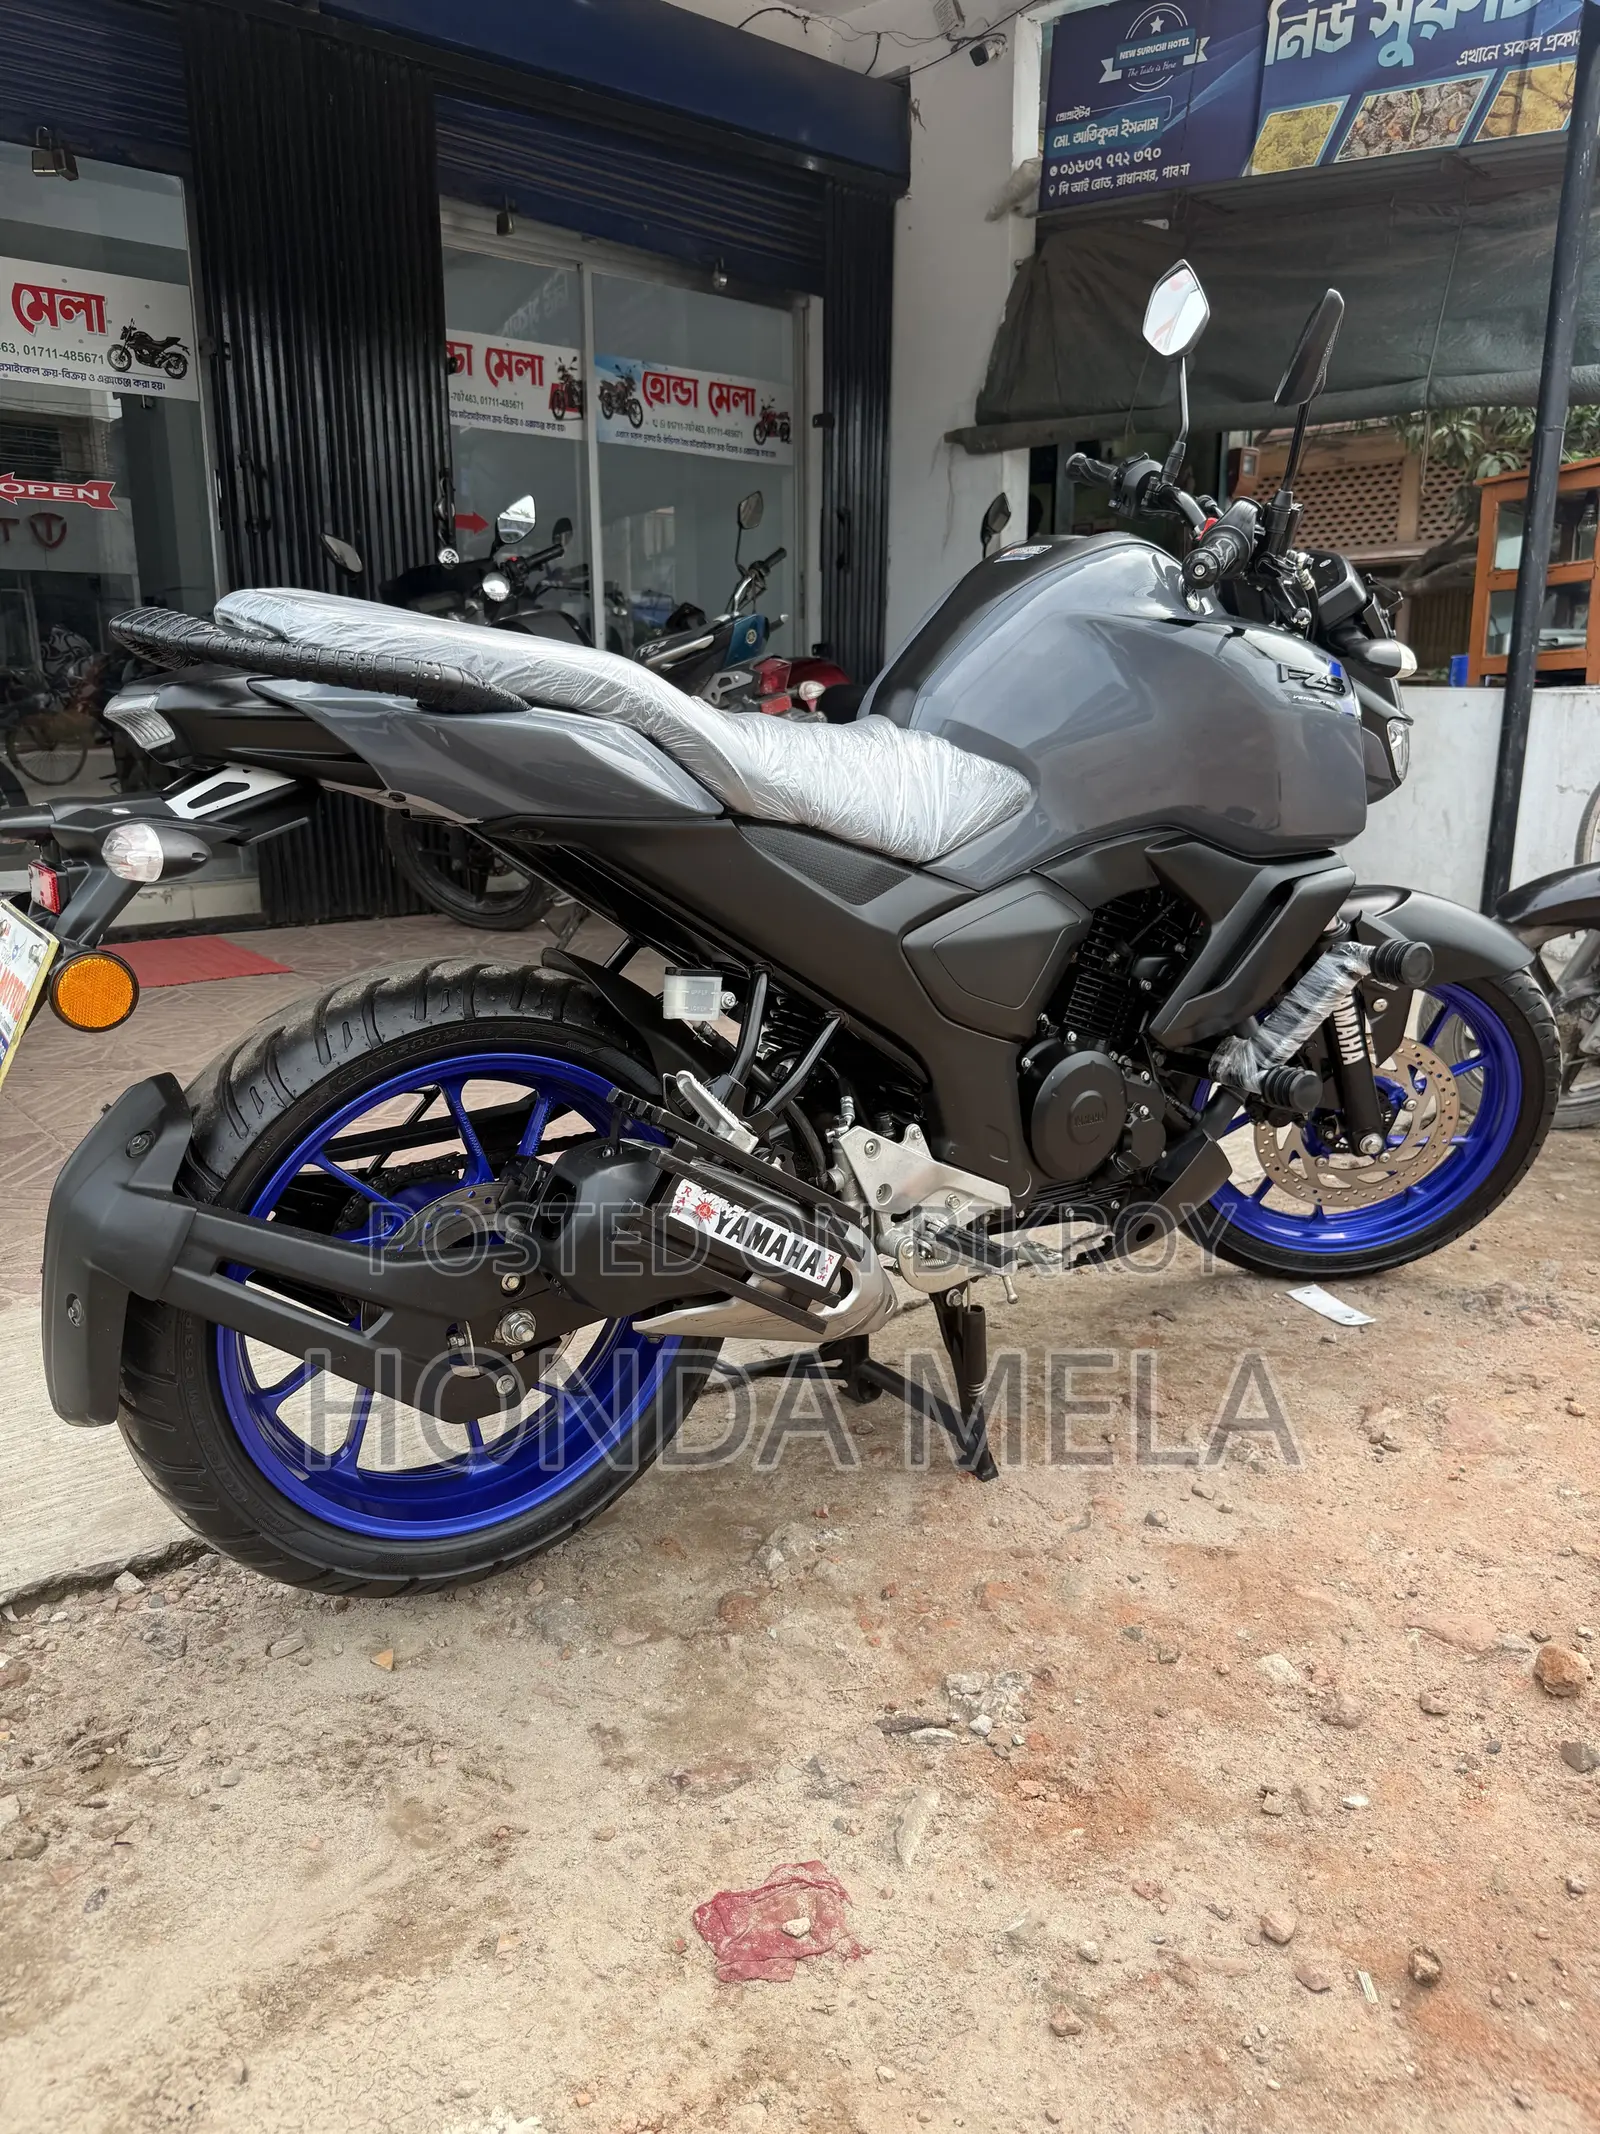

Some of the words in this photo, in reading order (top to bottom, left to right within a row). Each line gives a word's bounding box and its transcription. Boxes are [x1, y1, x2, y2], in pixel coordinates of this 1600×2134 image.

[1120, 49, 1136, 60] NEW
[1136, 42, 1167, 56] SURUCHI
[1167, 37, 1190, 49] HOTEL
[1456, 44, 1501, 66] এখানে
[1503, 35, 1543, 57] সকল
[1127, 68, 1138, 78] The
[1053, 135, 1070, 148] মো.
[1073, 124, 1118, 145] আতিকুল
[1121, 117, 1159, 138] ইসলাম
[1060, 156, 1103, 175] ০১৬৩৭
[1106, 152, 1130, 168] ৭৭২
[1133, 147, 1161, 162] ৩৭০
[1071, 178, 1089, 192] আই
[11, 282, 107, 335] মেলা
[23, 344, 104, 364] 01711-485671
[485, 347, 545, 387] মেলা
[133, 378, 150, 389] করা
[642, 371, 699, 408] হোন্ডা
[708, 380, 757, 417] মেলা
[0, 481, 100, 501] OPEN
[1333, 991, 1365, 1065] AMAHA
[714, 1209, 822, 1277] YAMAHA
